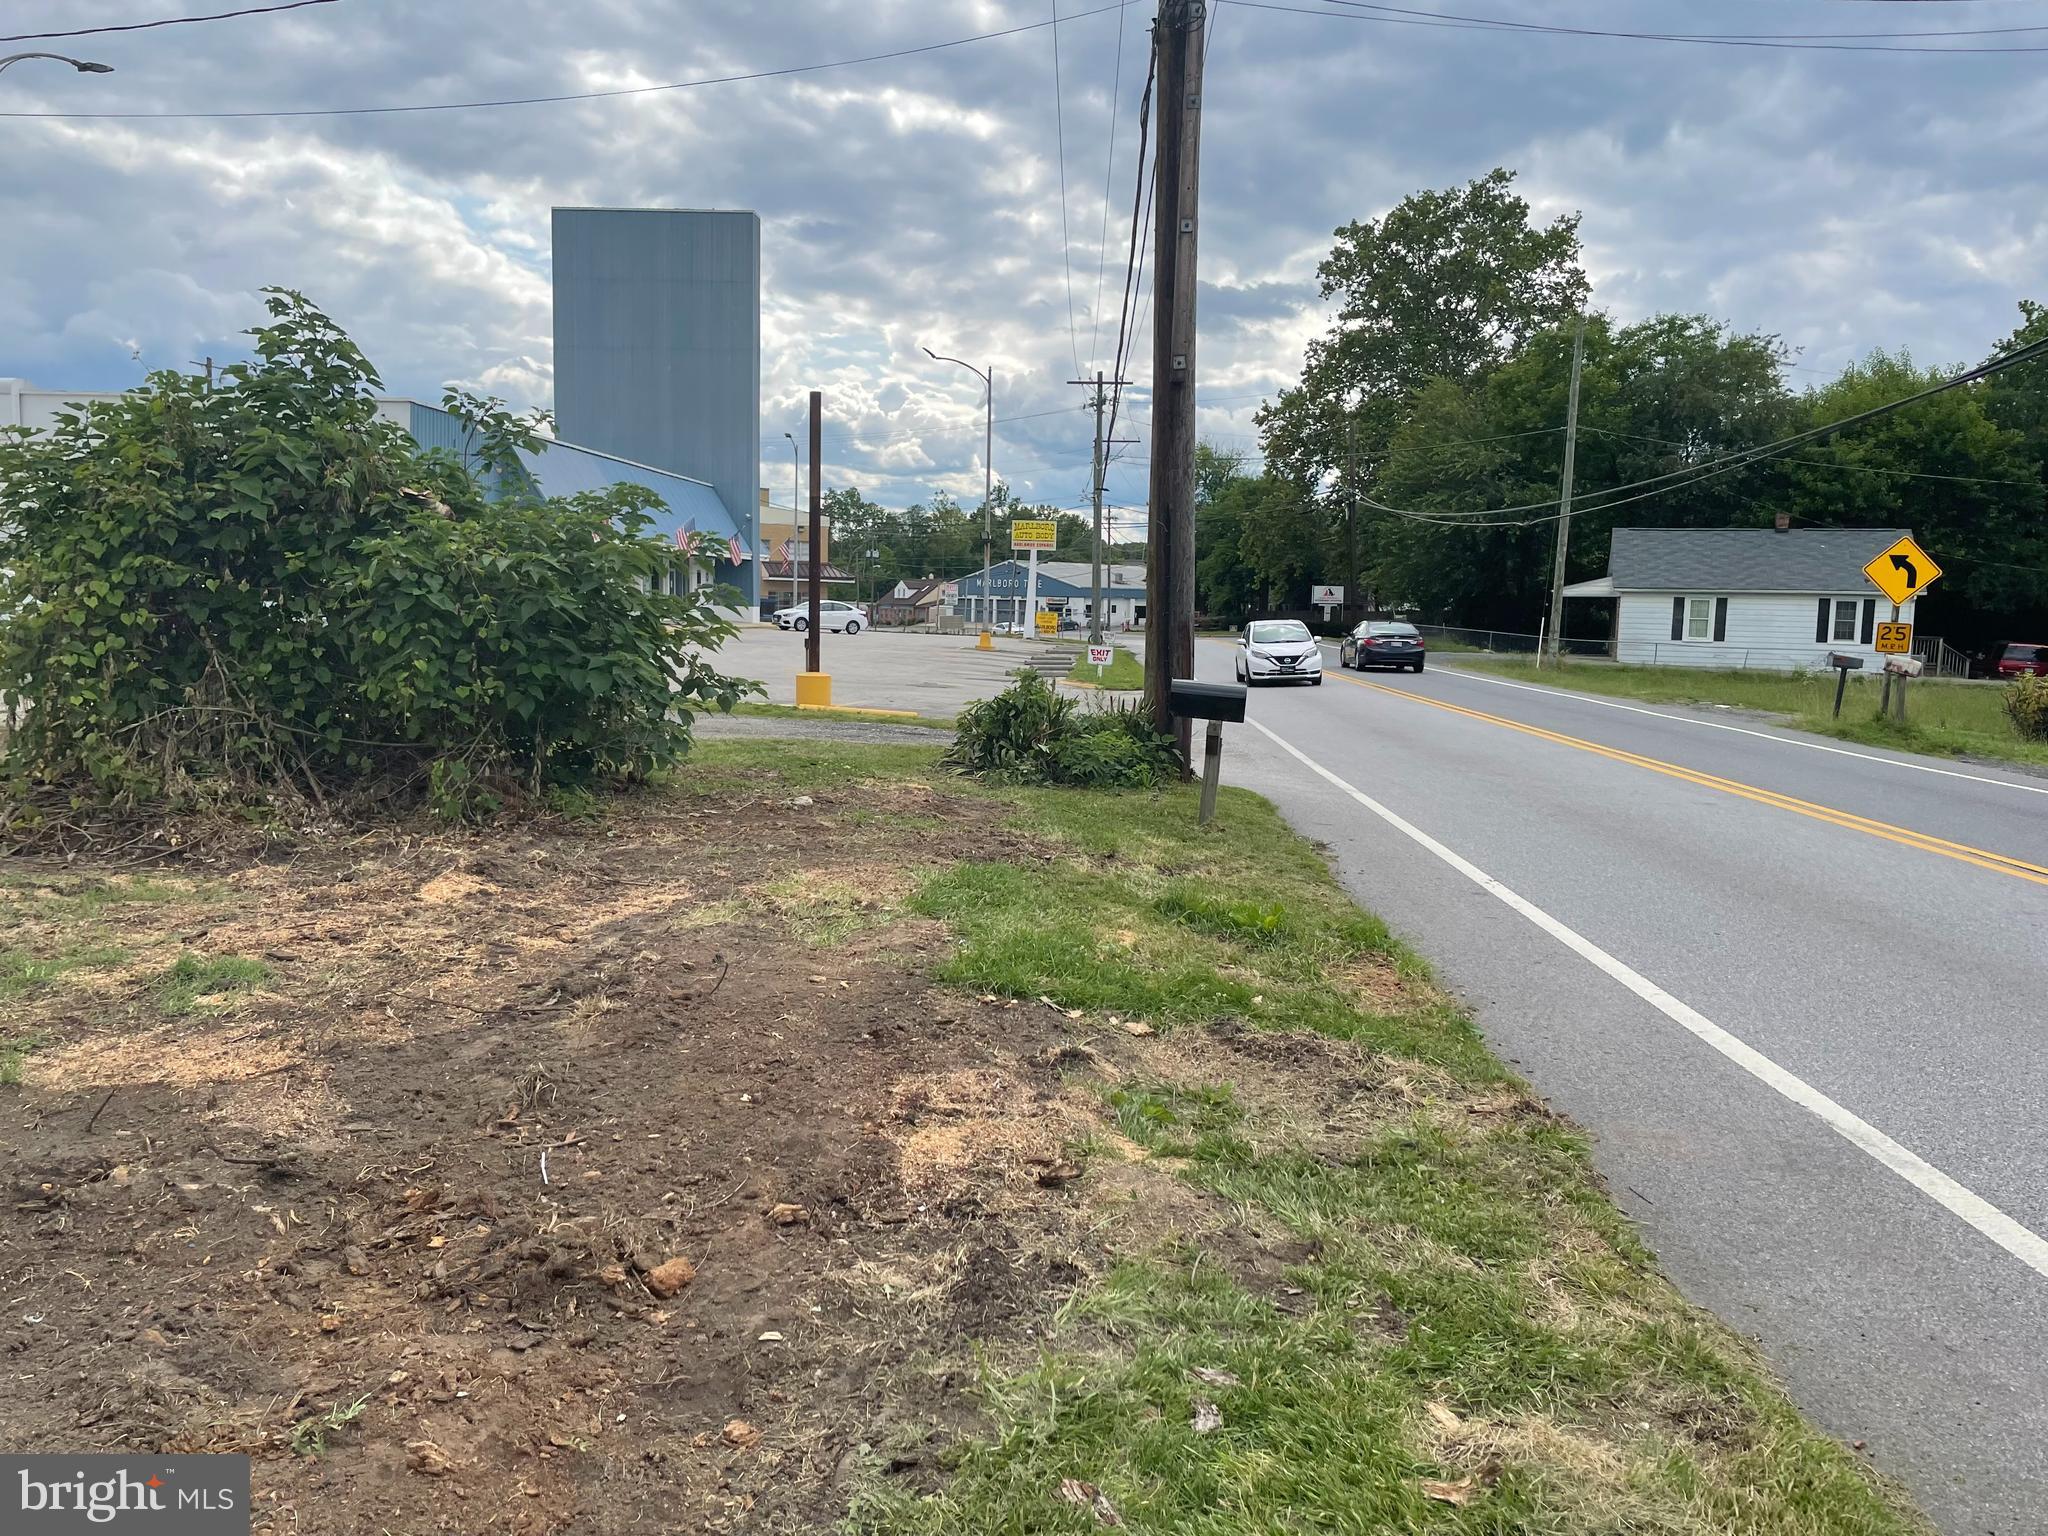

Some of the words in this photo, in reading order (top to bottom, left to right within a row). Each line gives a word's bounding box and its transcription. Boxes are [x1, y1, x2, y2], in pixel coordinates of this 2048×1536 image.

[1014, 522, 1055, 532] MARLBORO
[1023, 579, 1043, 588] TE
[1881, 626, 1906, 641] 25
